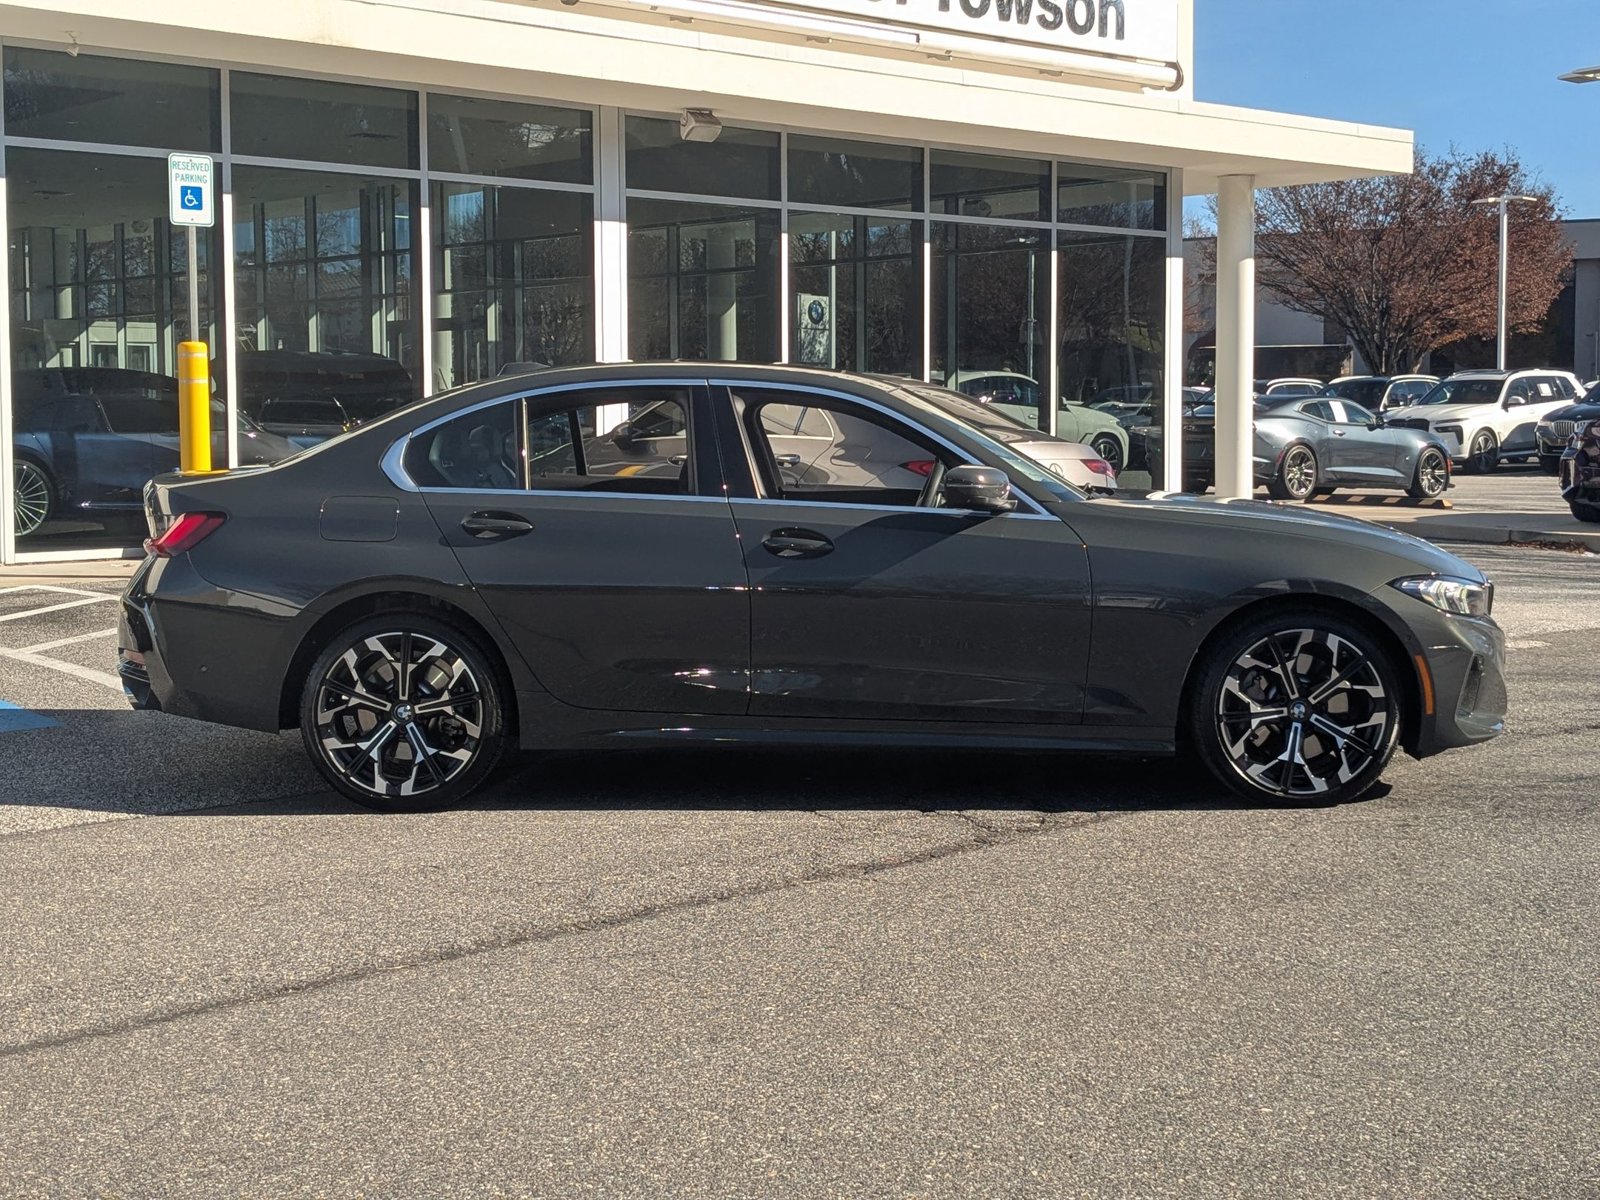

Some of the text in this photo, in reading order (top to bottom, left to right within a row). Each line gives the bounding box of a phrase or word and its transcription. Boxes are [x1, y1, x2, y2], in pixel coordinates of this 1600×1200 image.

[937, 0, 1125, 40] owson
[172, 160, 210, 172] RESERVED
[175, 173, 208, 184] PARKING
